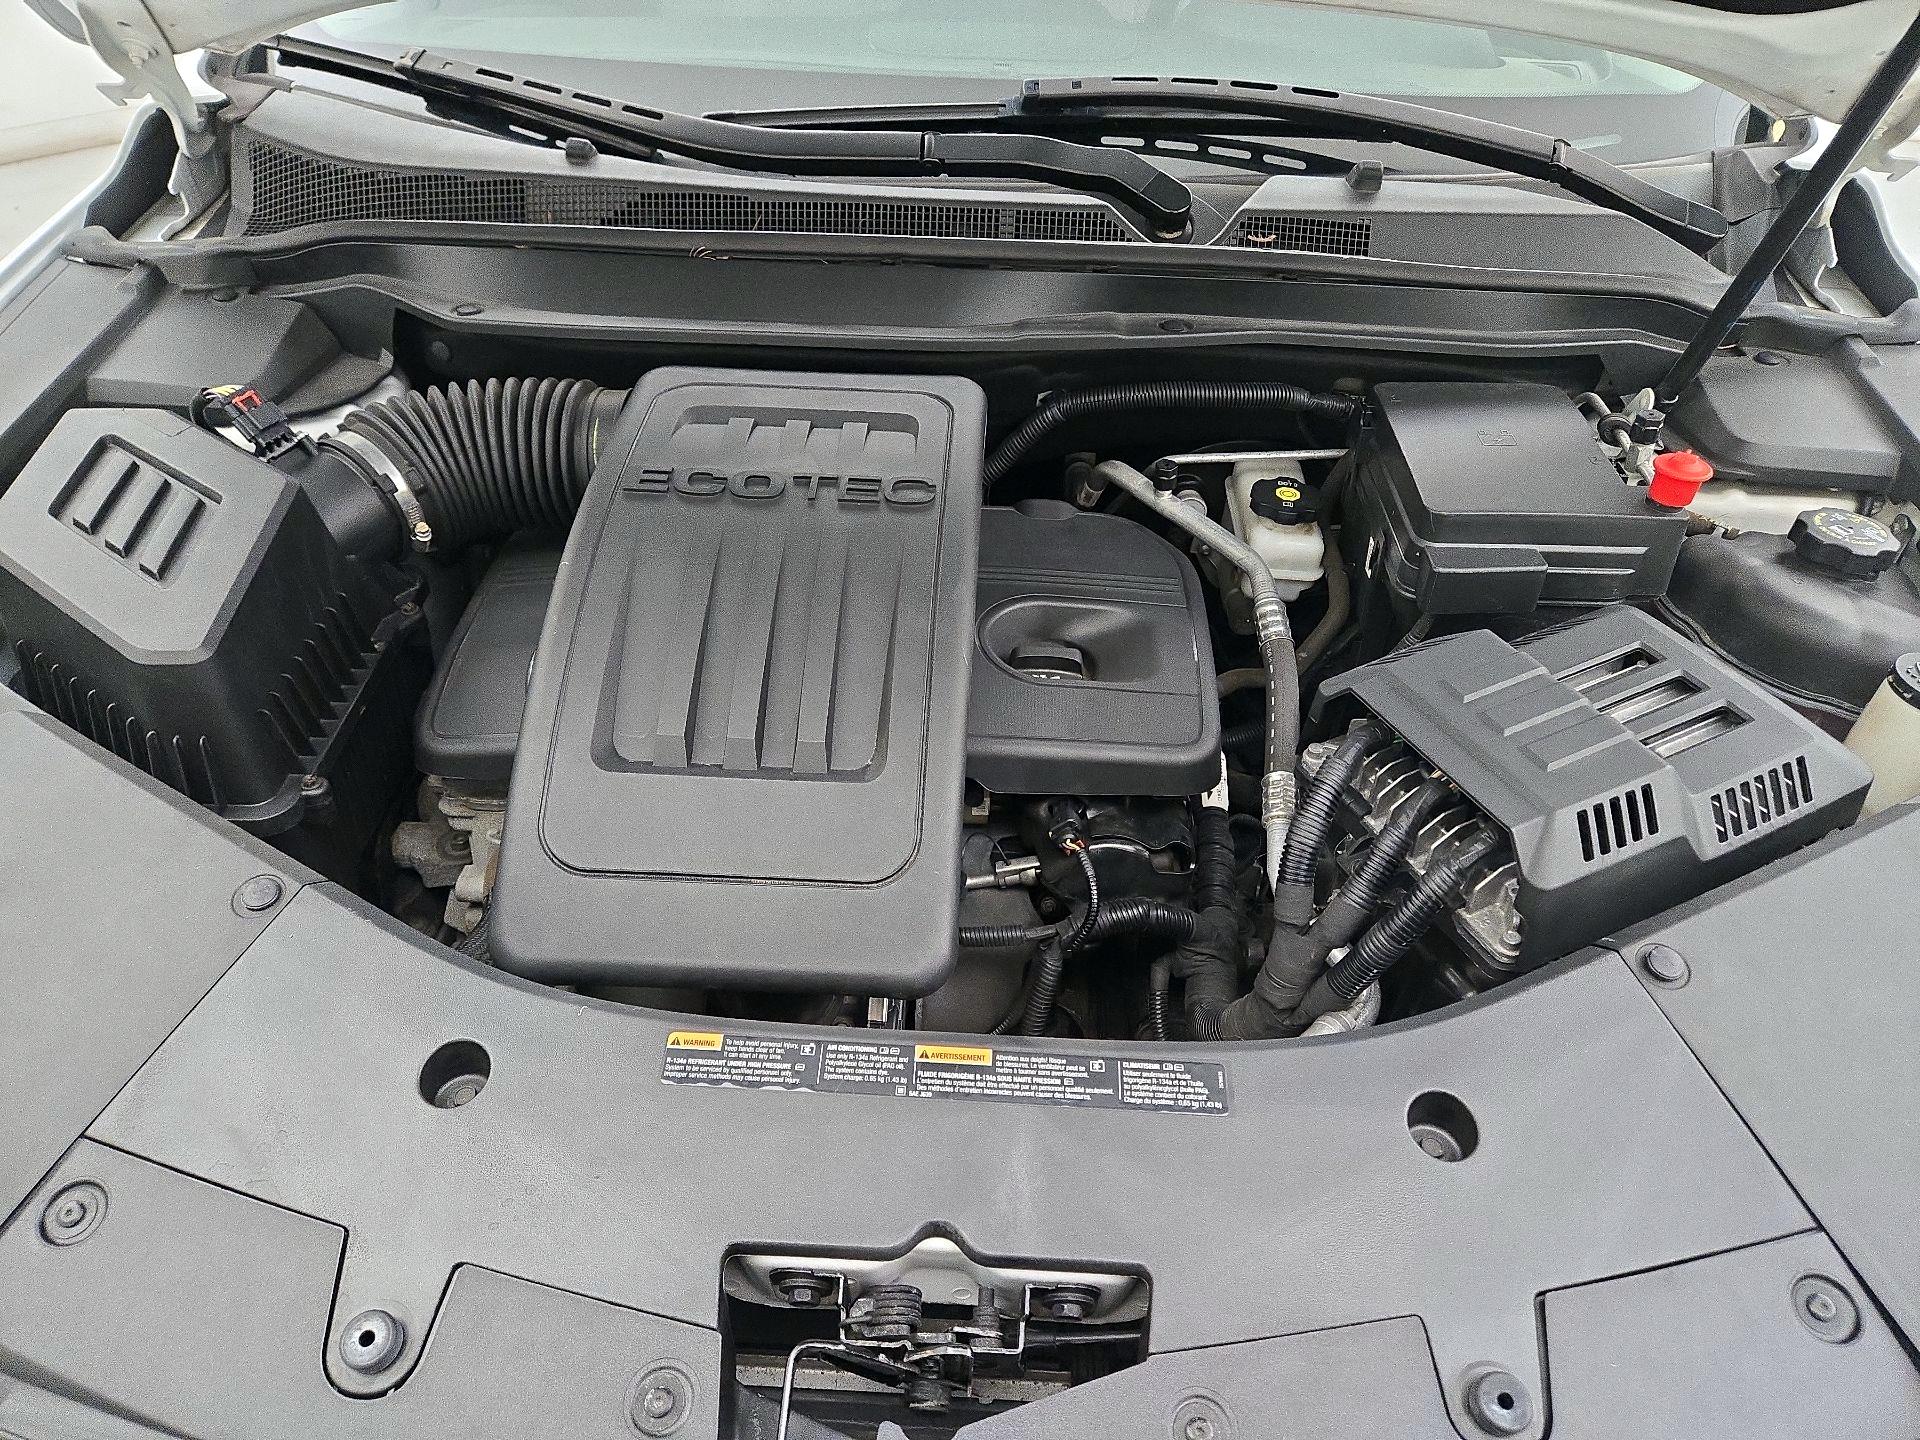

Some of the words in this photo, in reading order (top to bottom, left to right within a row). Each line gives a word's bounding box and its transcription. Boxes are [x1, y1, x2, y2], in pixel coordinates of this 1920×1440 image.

[622, 467, 936, 507] ECOTEC
[838, 1045, 878, 1054] CONDITIONING
[931, 1052, 986, 1062] AVERTISSEMENT
[688, 1058, 726, 1066] REFRIGERANT
[762, 1062, 792, 1070] PRESSURE
[918, 1070, 937, 1078] FLUIDE
[1032, 1077, 1061, 1085] PRESSION
